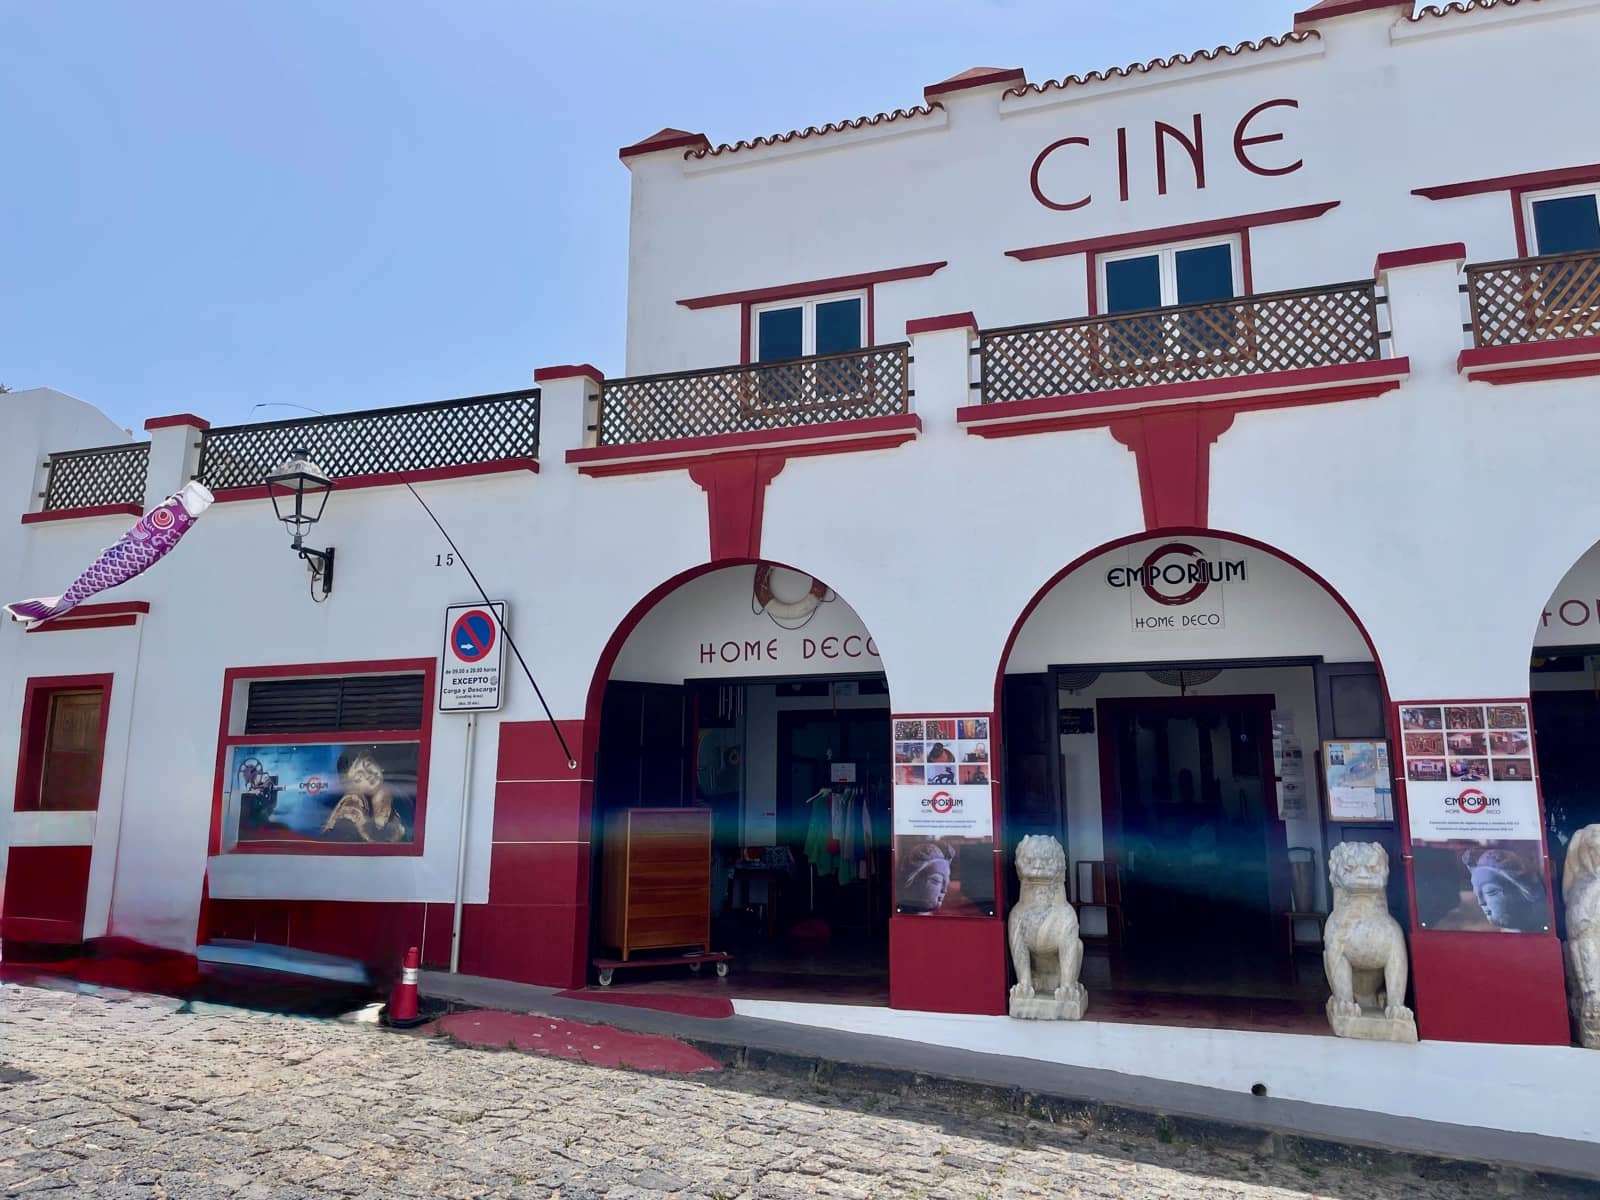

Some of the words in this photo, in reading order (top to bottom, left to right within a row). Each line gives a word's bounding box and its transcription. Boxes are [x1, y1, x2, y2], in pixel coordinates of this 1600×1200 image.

[1030, 98, 1303, 211] CINE
[434, 553, 454, 567] 15
[1107, 559, 1246, 588] EMPORIUM
[1135, 615, 1175, 629] HOME
[1182, 613, 1221, 627] DECO
[700, 638, 778, 663] HOME
[452, 676, 489, 685] EXCEPTO
[921, 798, 963, 807] EMPORIUM
[1444, 797, 1500, 806] EMPORIUM
